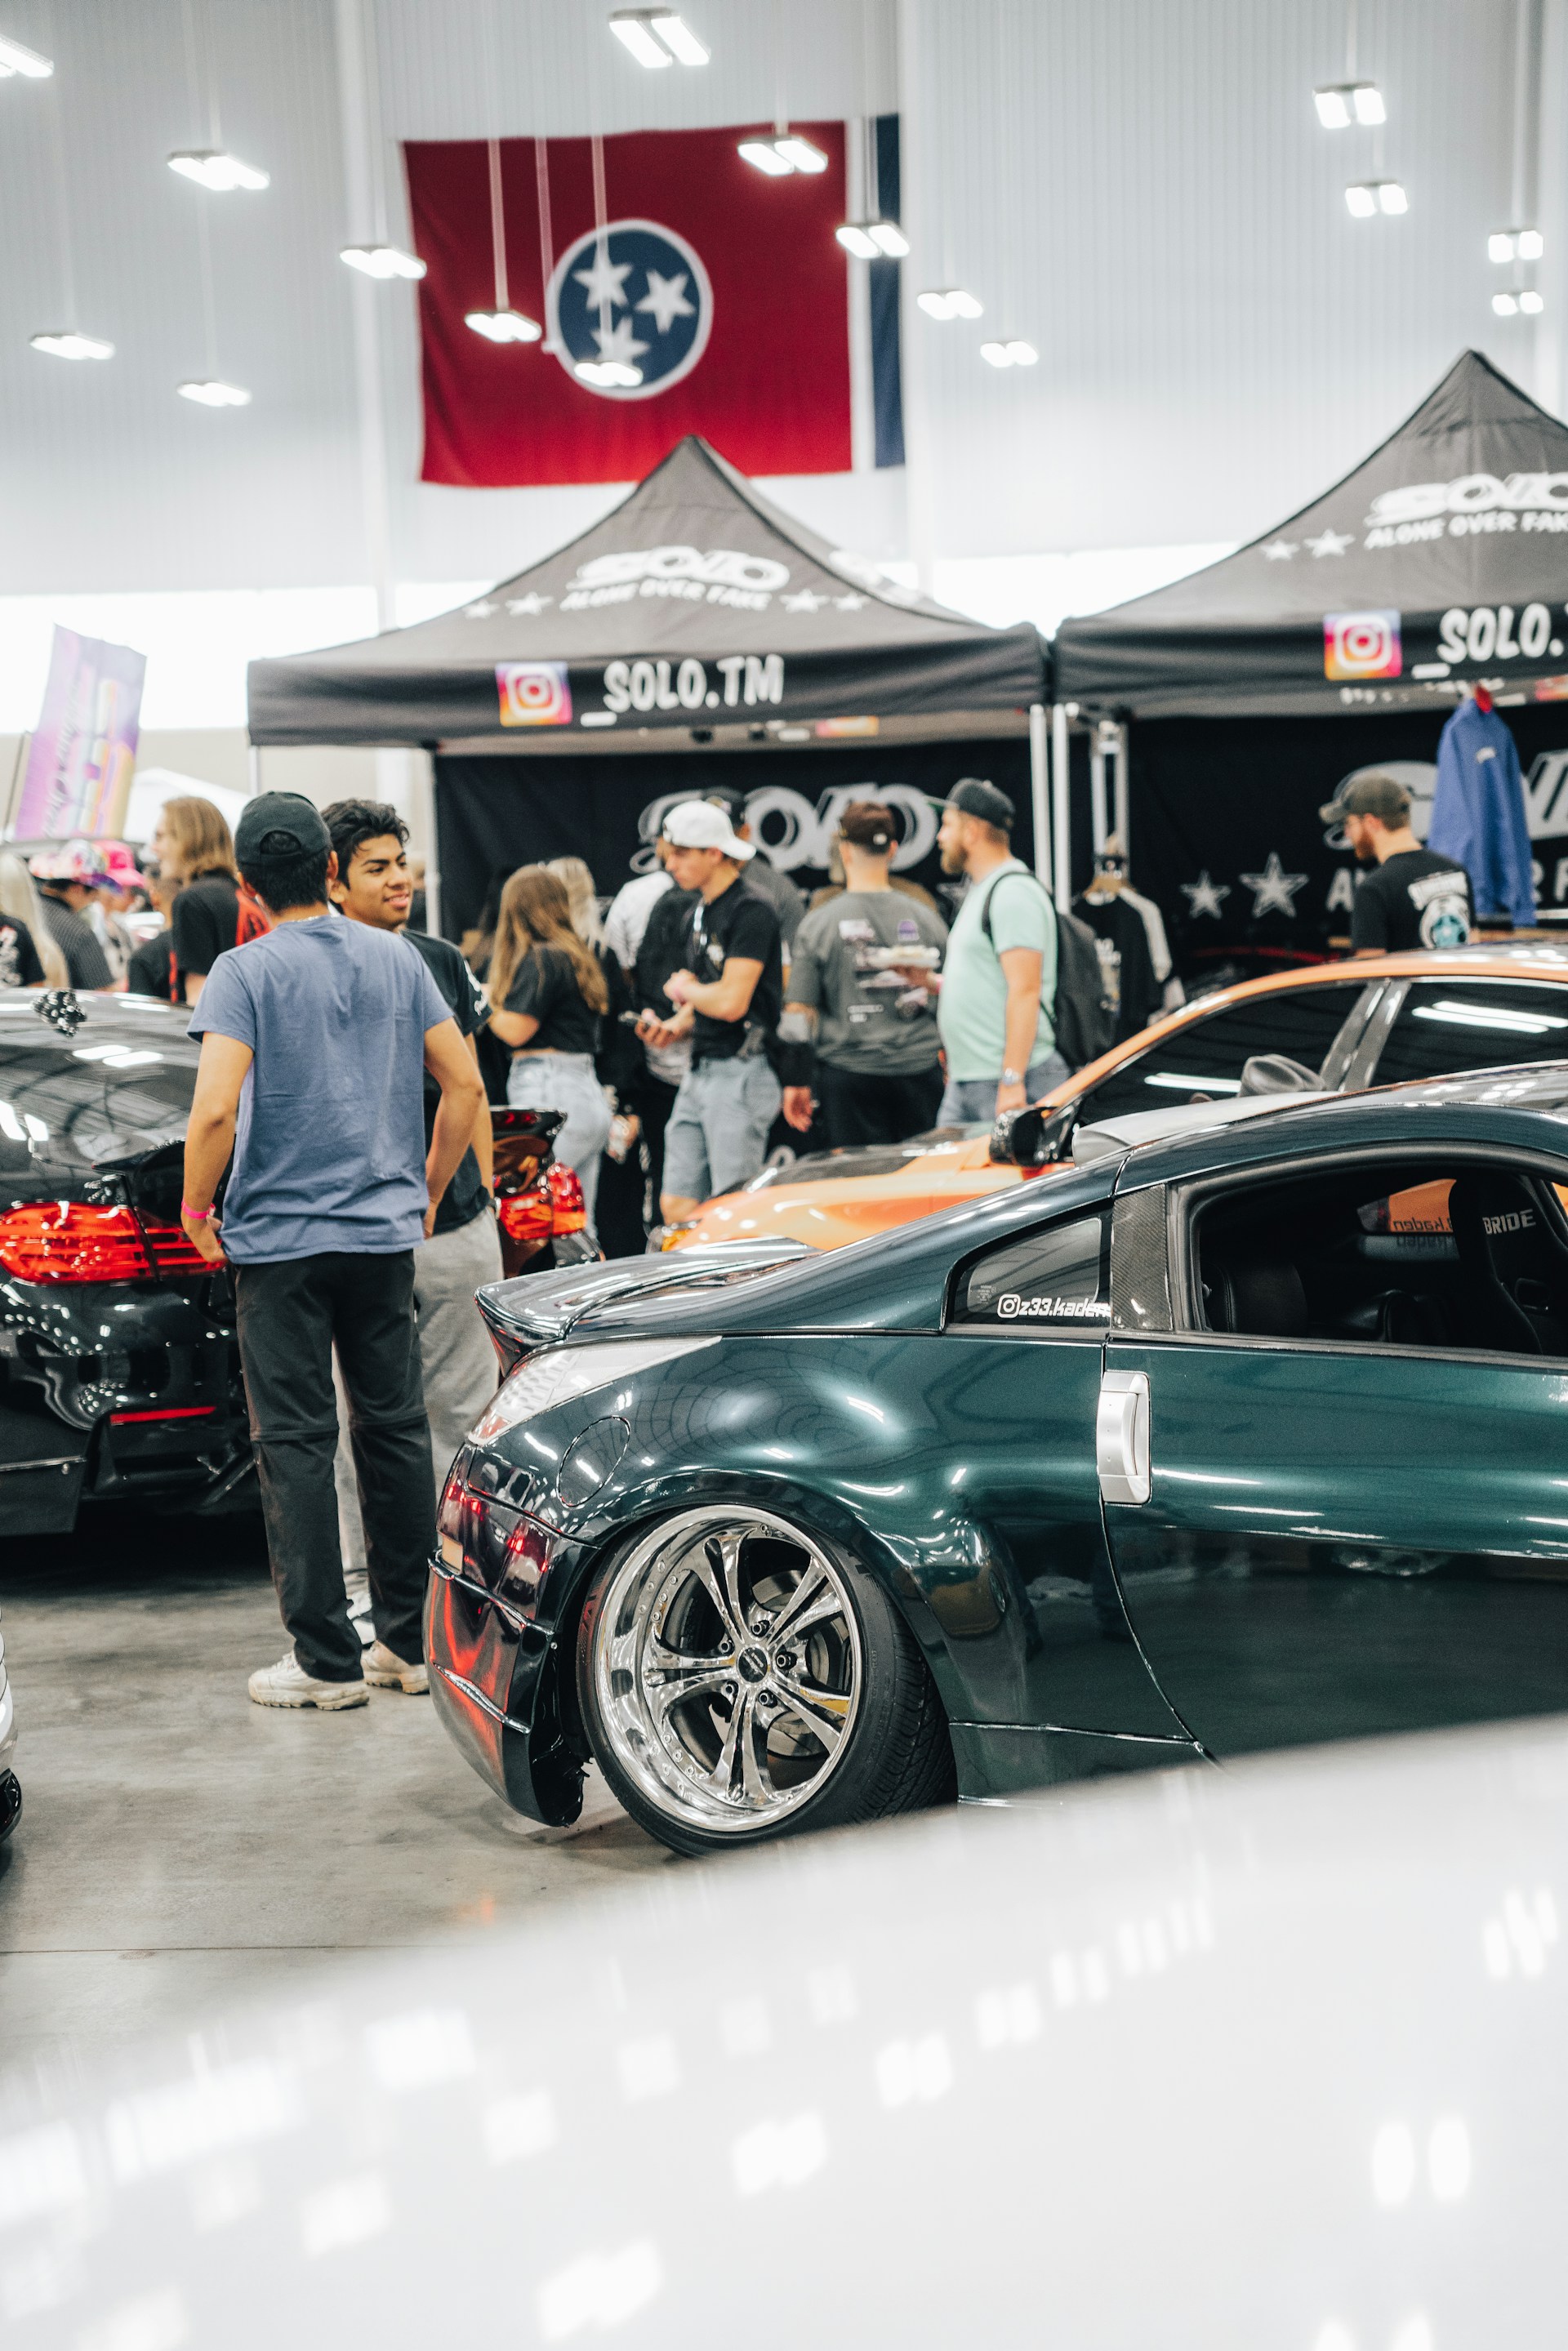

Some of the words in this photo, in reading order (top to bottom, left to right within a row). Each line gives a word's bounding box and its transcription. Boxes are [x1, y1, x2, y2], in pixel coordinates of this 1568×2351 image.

[1364, 517, 1445, 550] ALONE
[1449, 511, 1517, 537] OVER
[1521, 511, 1568, 533] FAK
[559, 582, 639, 611] ALONE
[639, 578, 706, 601] OVER
[706, 585, 772, 611] FAKE
[1482, 1208, 1536, 1236] BRIDE
